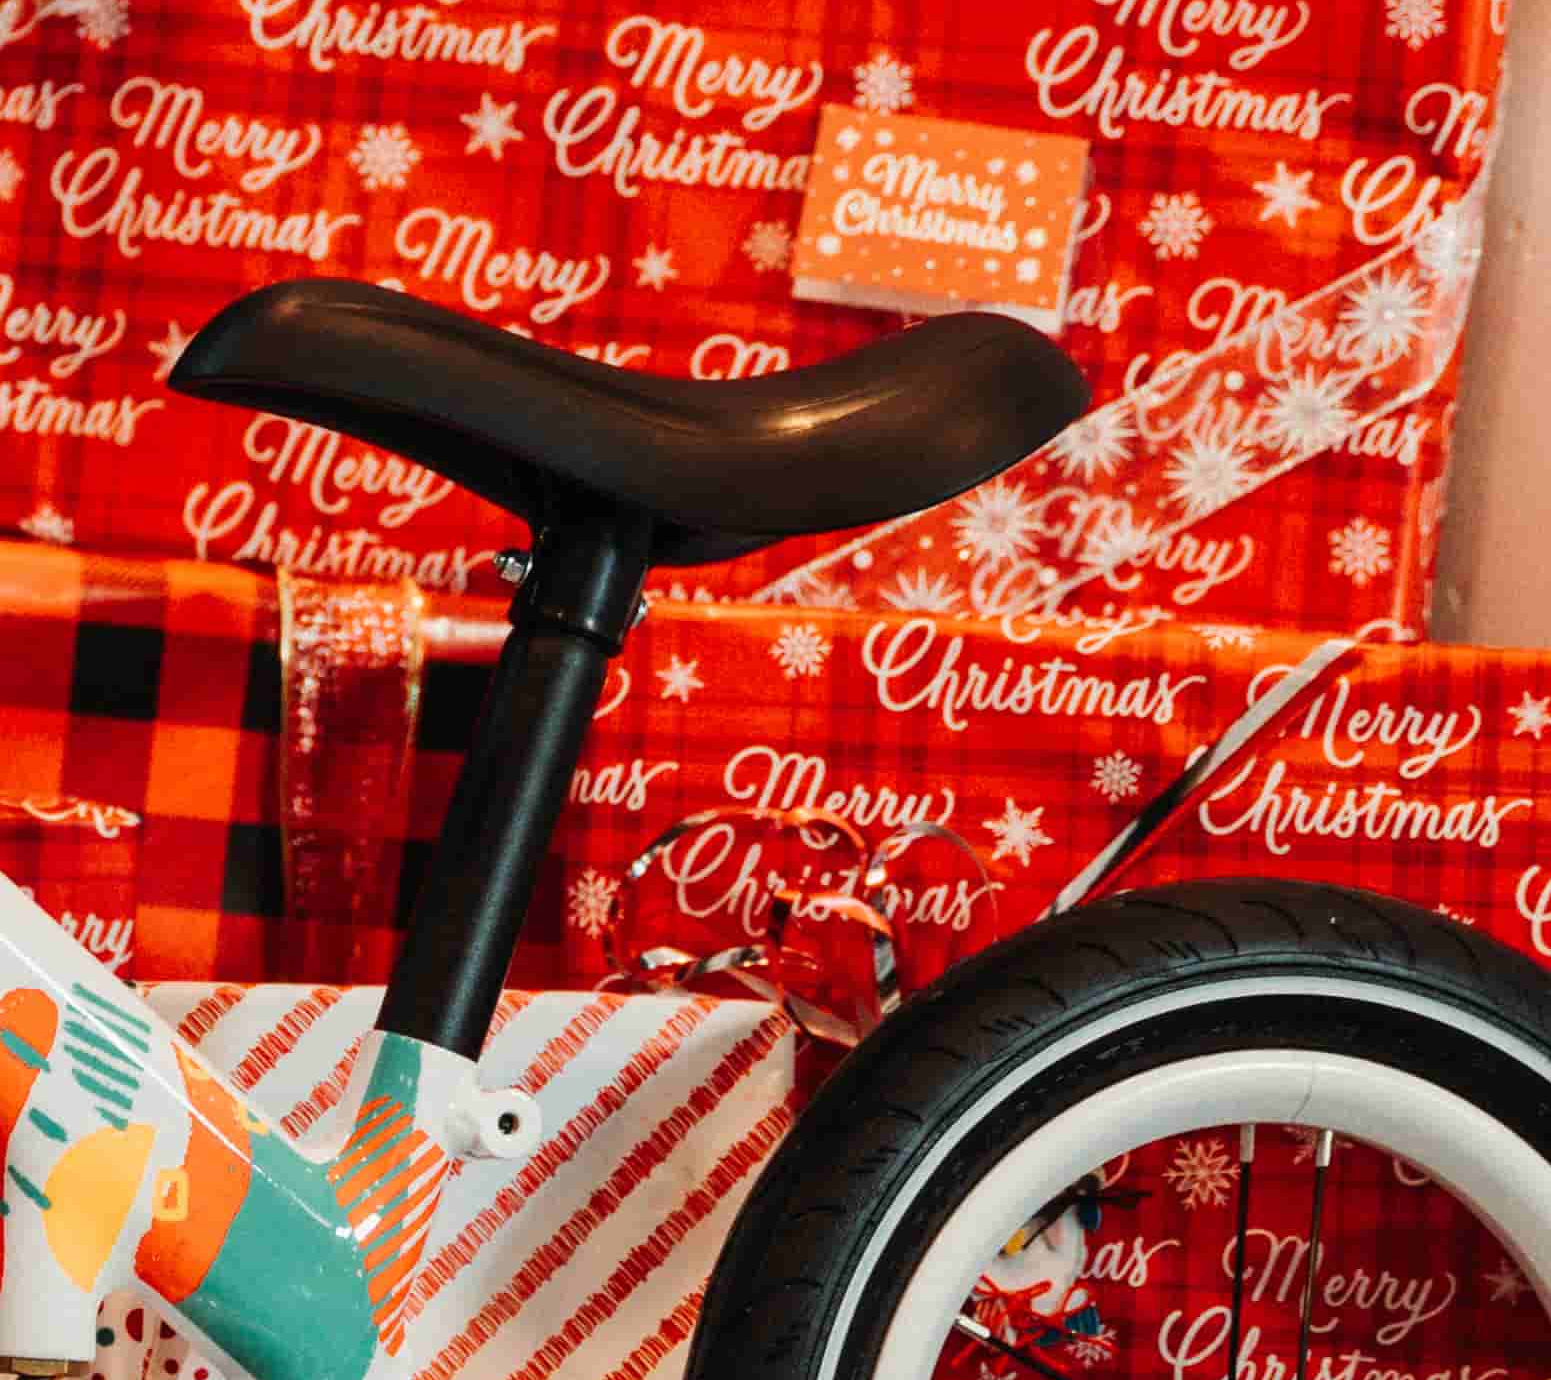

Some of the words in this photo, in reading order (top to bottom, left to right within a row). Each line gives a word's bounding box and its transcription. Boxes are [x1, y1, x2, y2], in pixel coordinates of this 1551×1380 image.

[606, 15, 824, 131] Merry
[1024, 25, 1353, 140] Christmas
[110, 76, 322, 191] Merry
[544, 86, 810, 198] Christma
[863, 152, 1006, 218] Merry
[50, 147, 360, 261] Christmas
[832, 187, 1017, 252] Christmas
[394, 207, 610, 323] Merry
[862, 618, 1207, 731] Christmas
